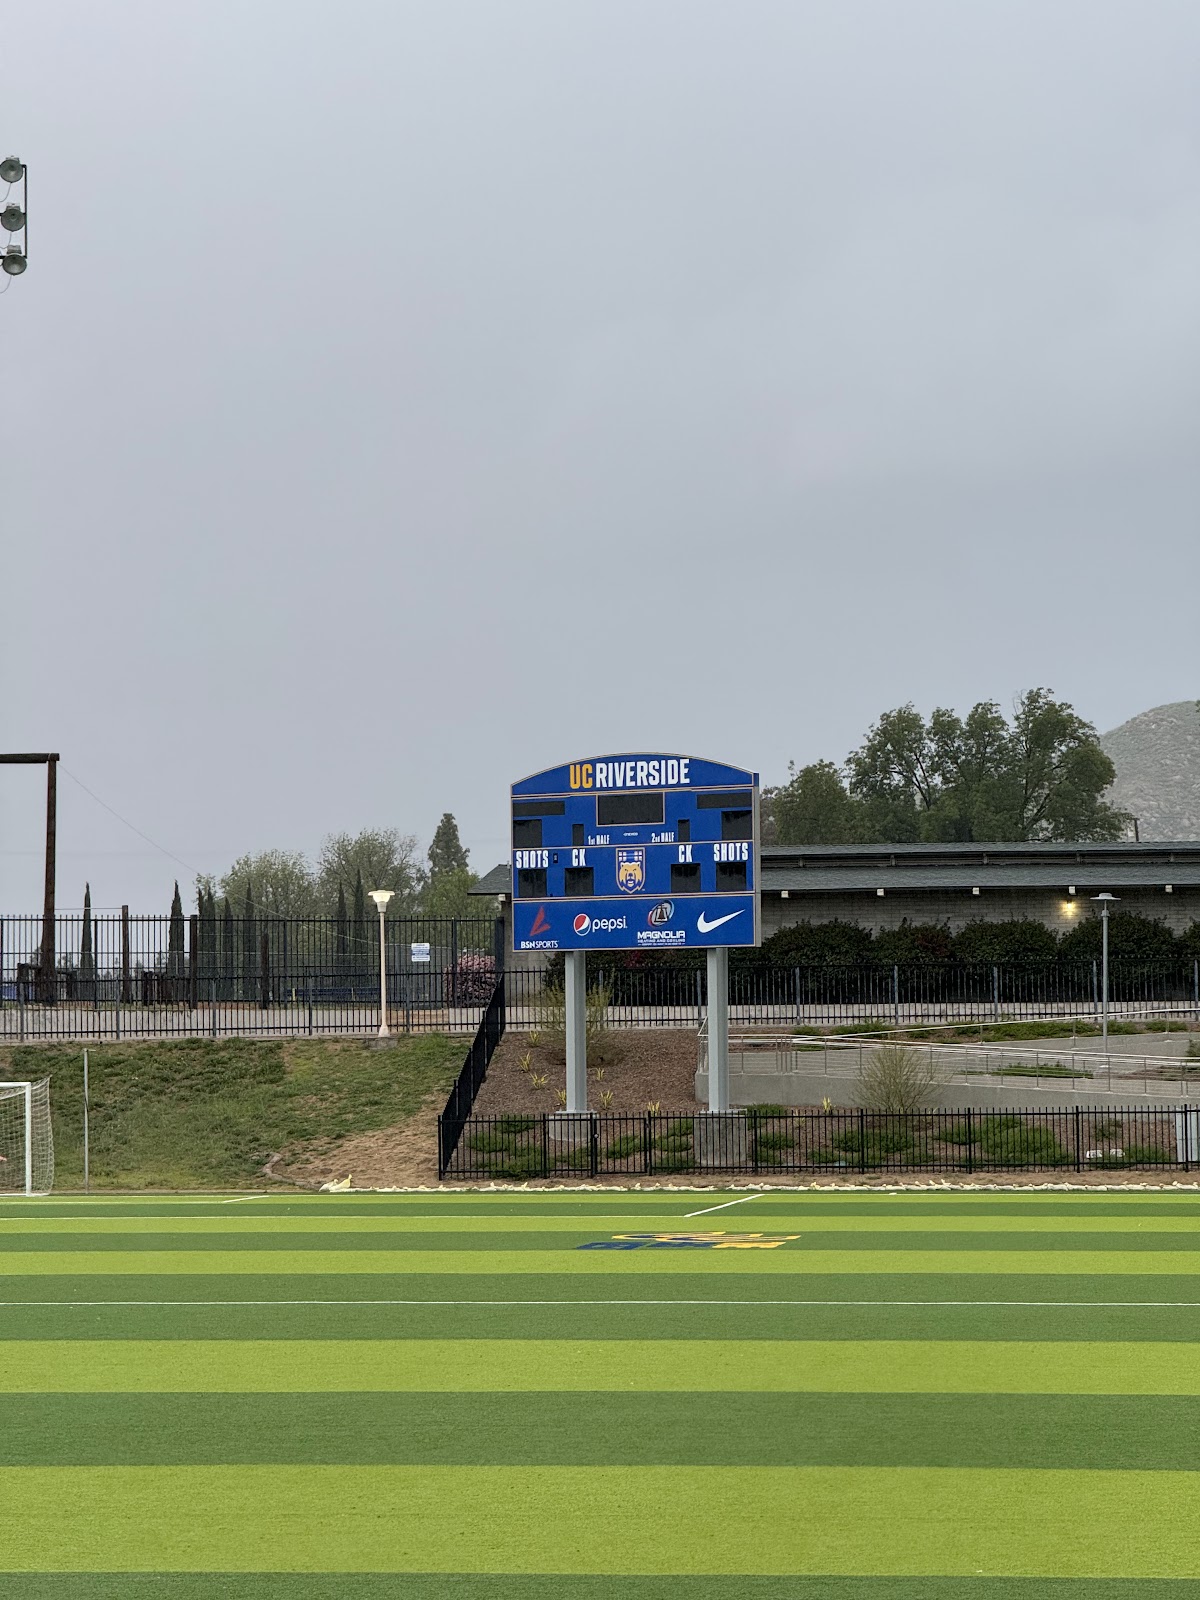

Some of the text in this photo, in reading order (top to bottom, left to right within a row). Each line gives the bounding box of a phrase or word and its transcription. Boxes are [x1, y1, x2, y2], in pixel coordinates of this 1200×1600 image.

[569, 758, 690, 789] UC RIVERSIDE
[596, 834, 610, 845] HALF
[651, 833, 661, 843] 2nd
[661, 832, 675, 843] HALF
[515, 850, 549, 869] SHOTS
[572, 848, 586, 867] CK
[678, 844, 693, 863] CK
[713, 842, 749, 862] SHOTS
[592, 916, 627, 932] pepsi
[637, 930, 686, 939] MAGNOLIA
